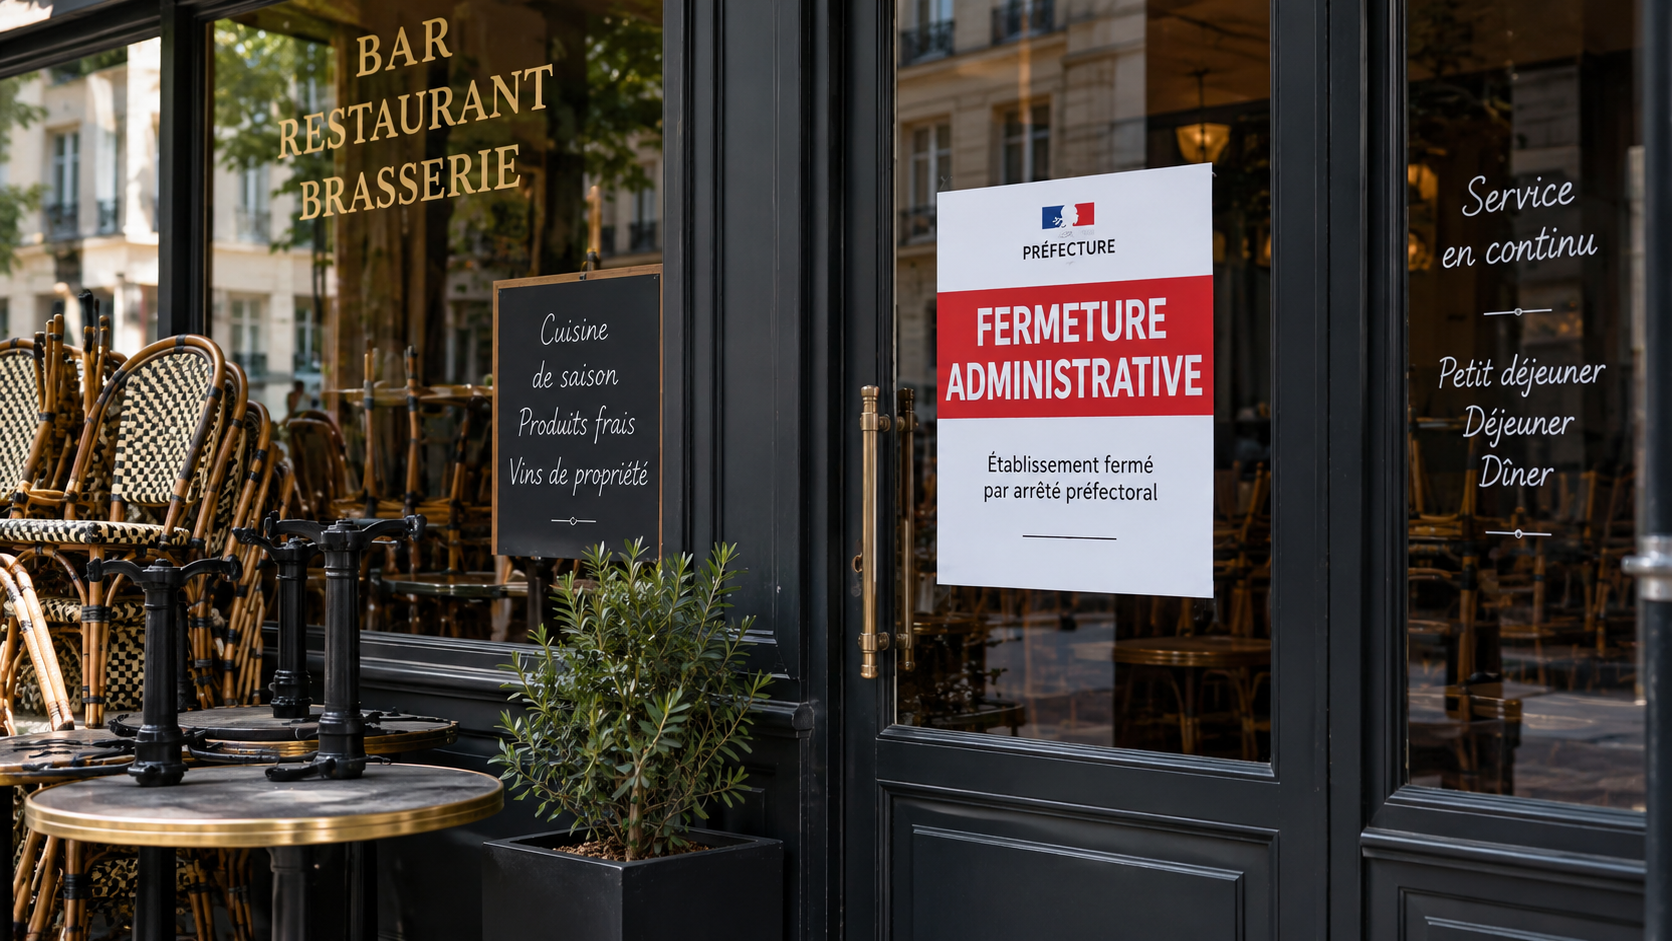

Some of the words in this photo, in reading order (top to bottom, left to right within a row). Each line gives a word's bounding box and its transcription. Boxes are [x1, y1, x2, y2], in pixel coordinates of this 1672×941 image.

[356, 16, 453, 77] BAR
[278, 63, 554, 160] RESTAURANT
[298, 144, 521, 222] BRASSERIE
[1461, 175, 1575, 217] Service
[1023, 239, 1116, 260] PRÉFECTURE
[1442, 245, 1476, 269] en
[1485, 226, 1598, 265] continu
[540, 313, 609, 346] Cuisine
[976, 297, 1167, 347] FERMETURE
[532, 360, 554, 389] de
[560, 363, 619, 388] saison
[945, 354, 1203, 402] ADMINISTRATIVE
[1438, 356, 1494, 389] Petit
[1500, 353, 1606, 398] déjeuner
[518, 406, 588, 437] Produits
[594, 405, 636, 444] frais
[1462, 405, 1575, 448] Déjeuner
[509, 456, 543, 485] Vins
[549, 456, 568, 485] de
[572, 460, 648, 497] propriété
[987, 451, 1100, 474] Établissement
[1104, 454, 1154, 474] fermé
[1478, 454, 1554, 488] Dîner
[983, 484, 1009, 503] par
[1013, 480, 1062, 500] arrêté
[1066, 482, 1158, 504] préfectoral
